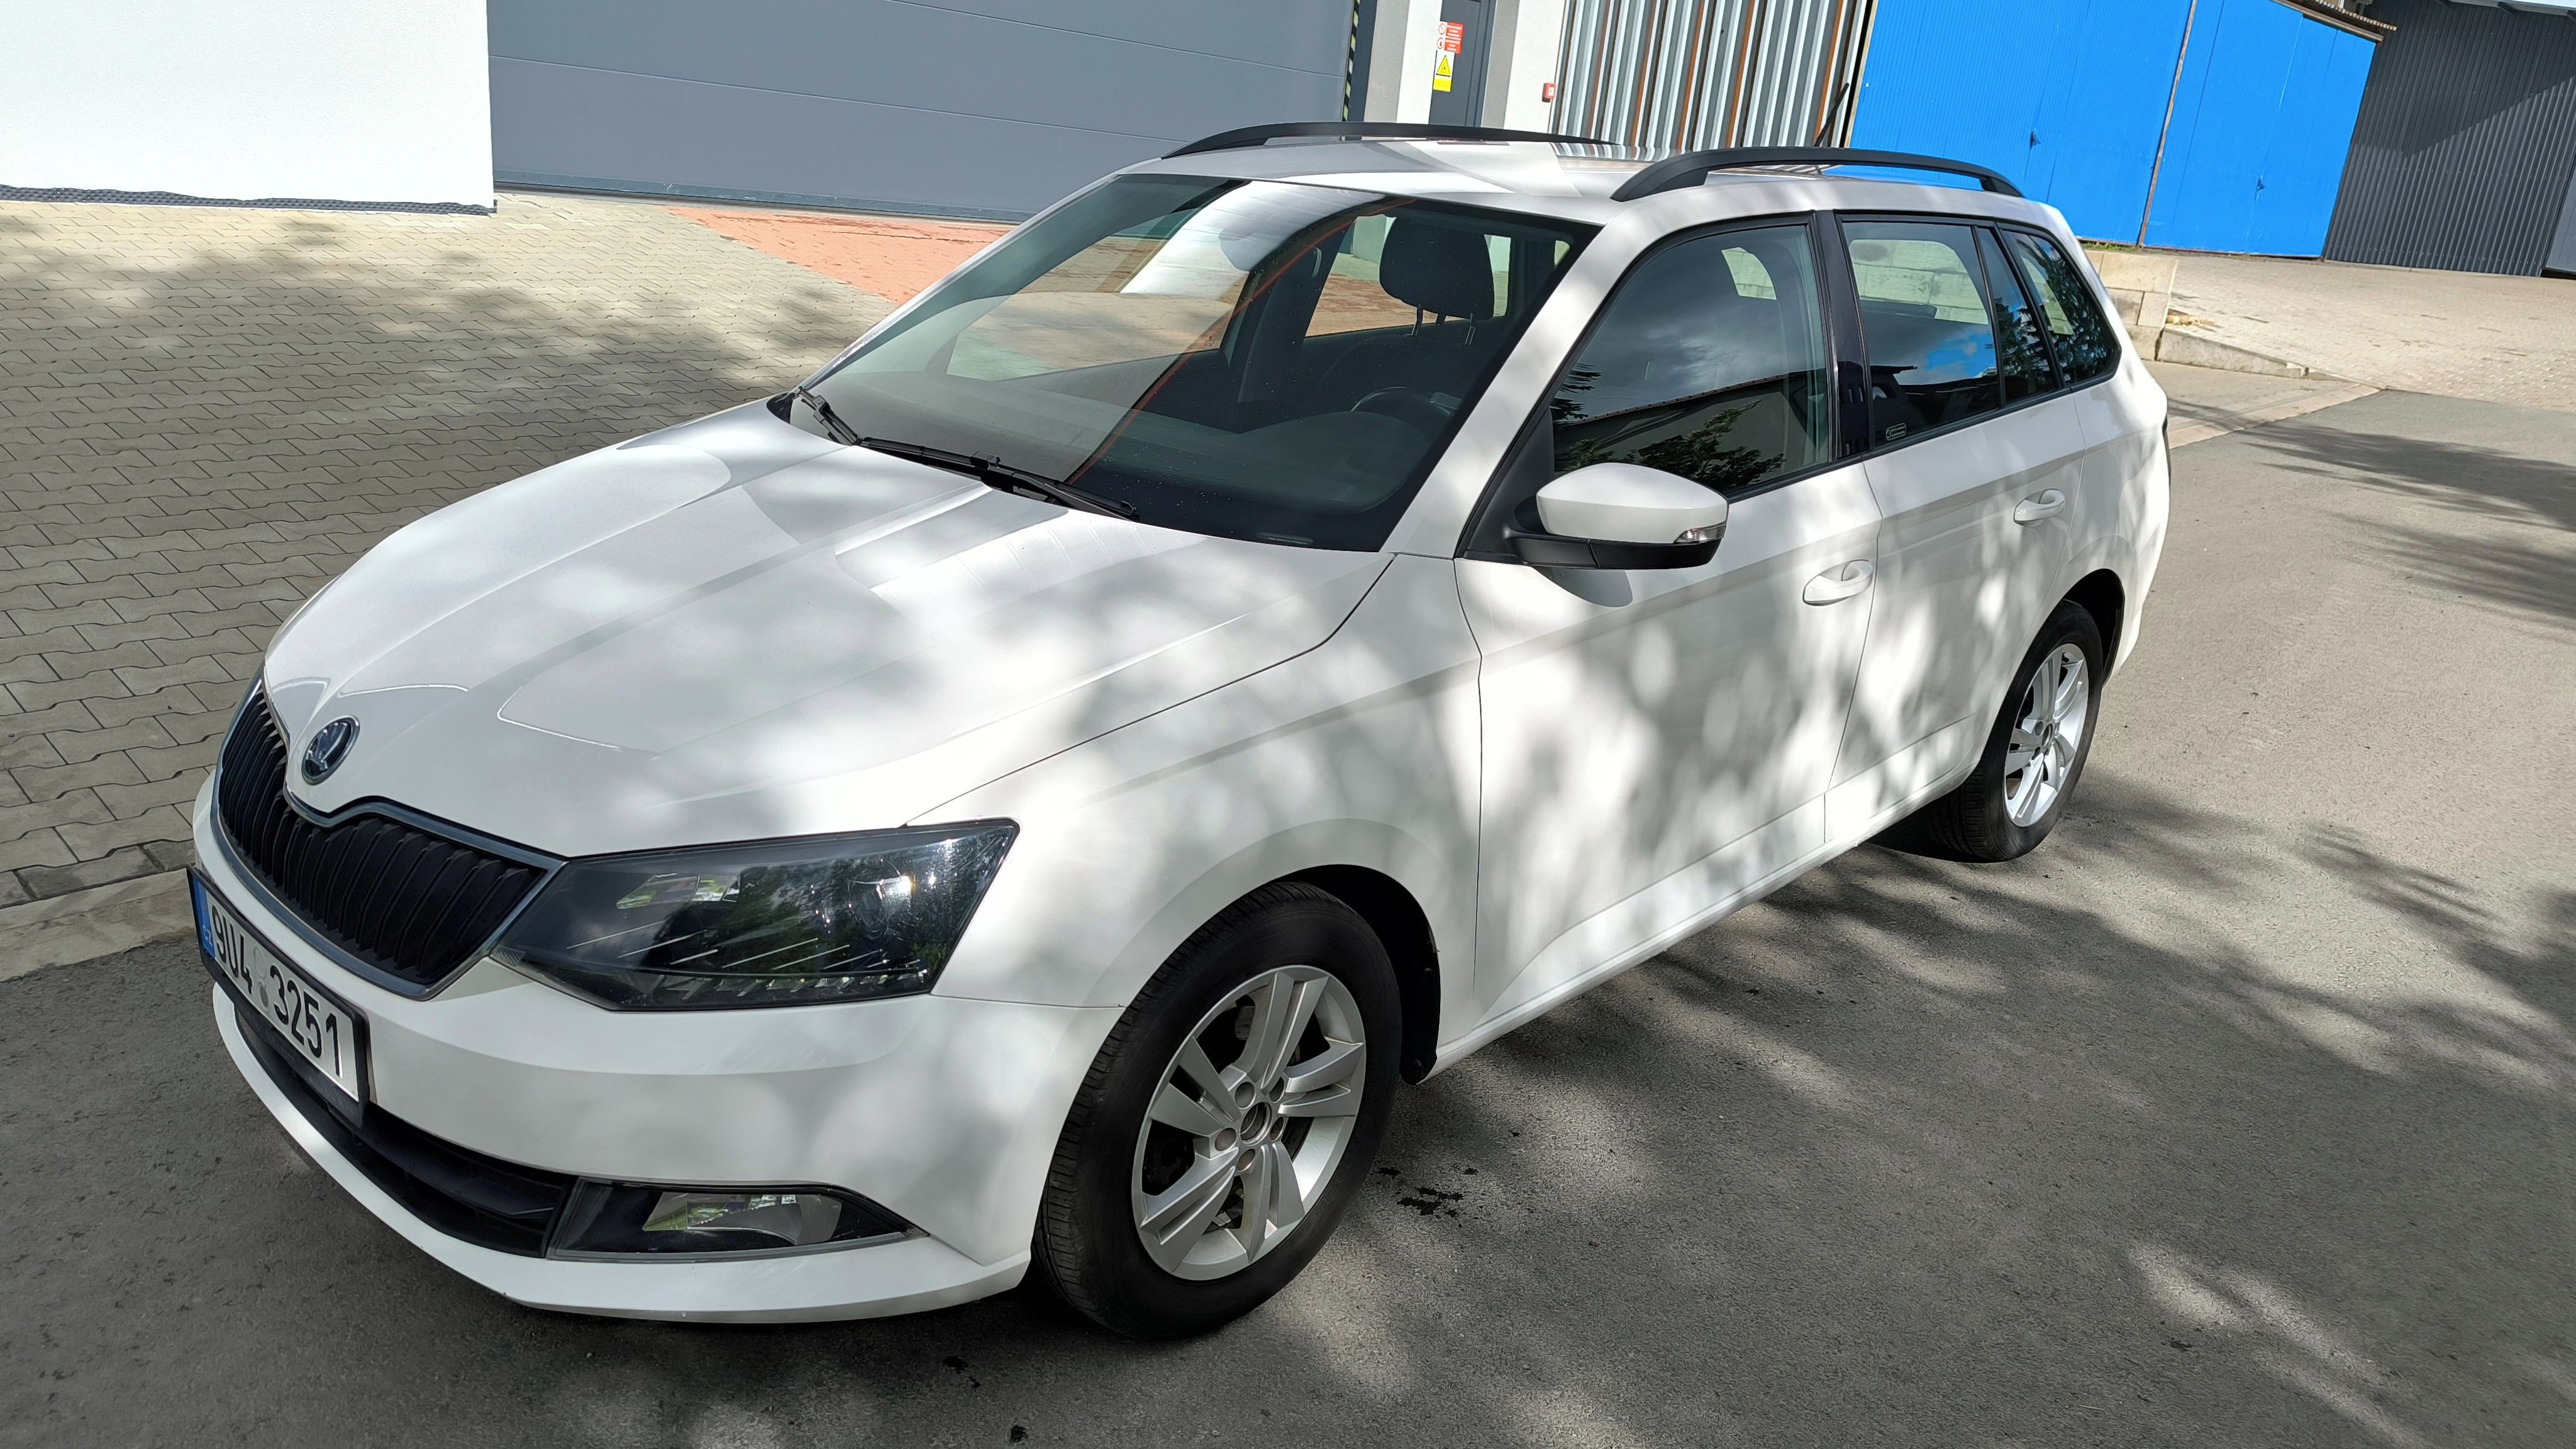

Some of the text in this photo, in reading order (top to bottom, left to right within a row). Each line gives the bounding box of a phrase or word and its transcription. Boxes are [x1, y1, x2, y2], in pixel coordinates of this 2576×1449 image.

[203, 924, 213, 947] CZ
[212, 904, 340, 1077] 9U4 3251
